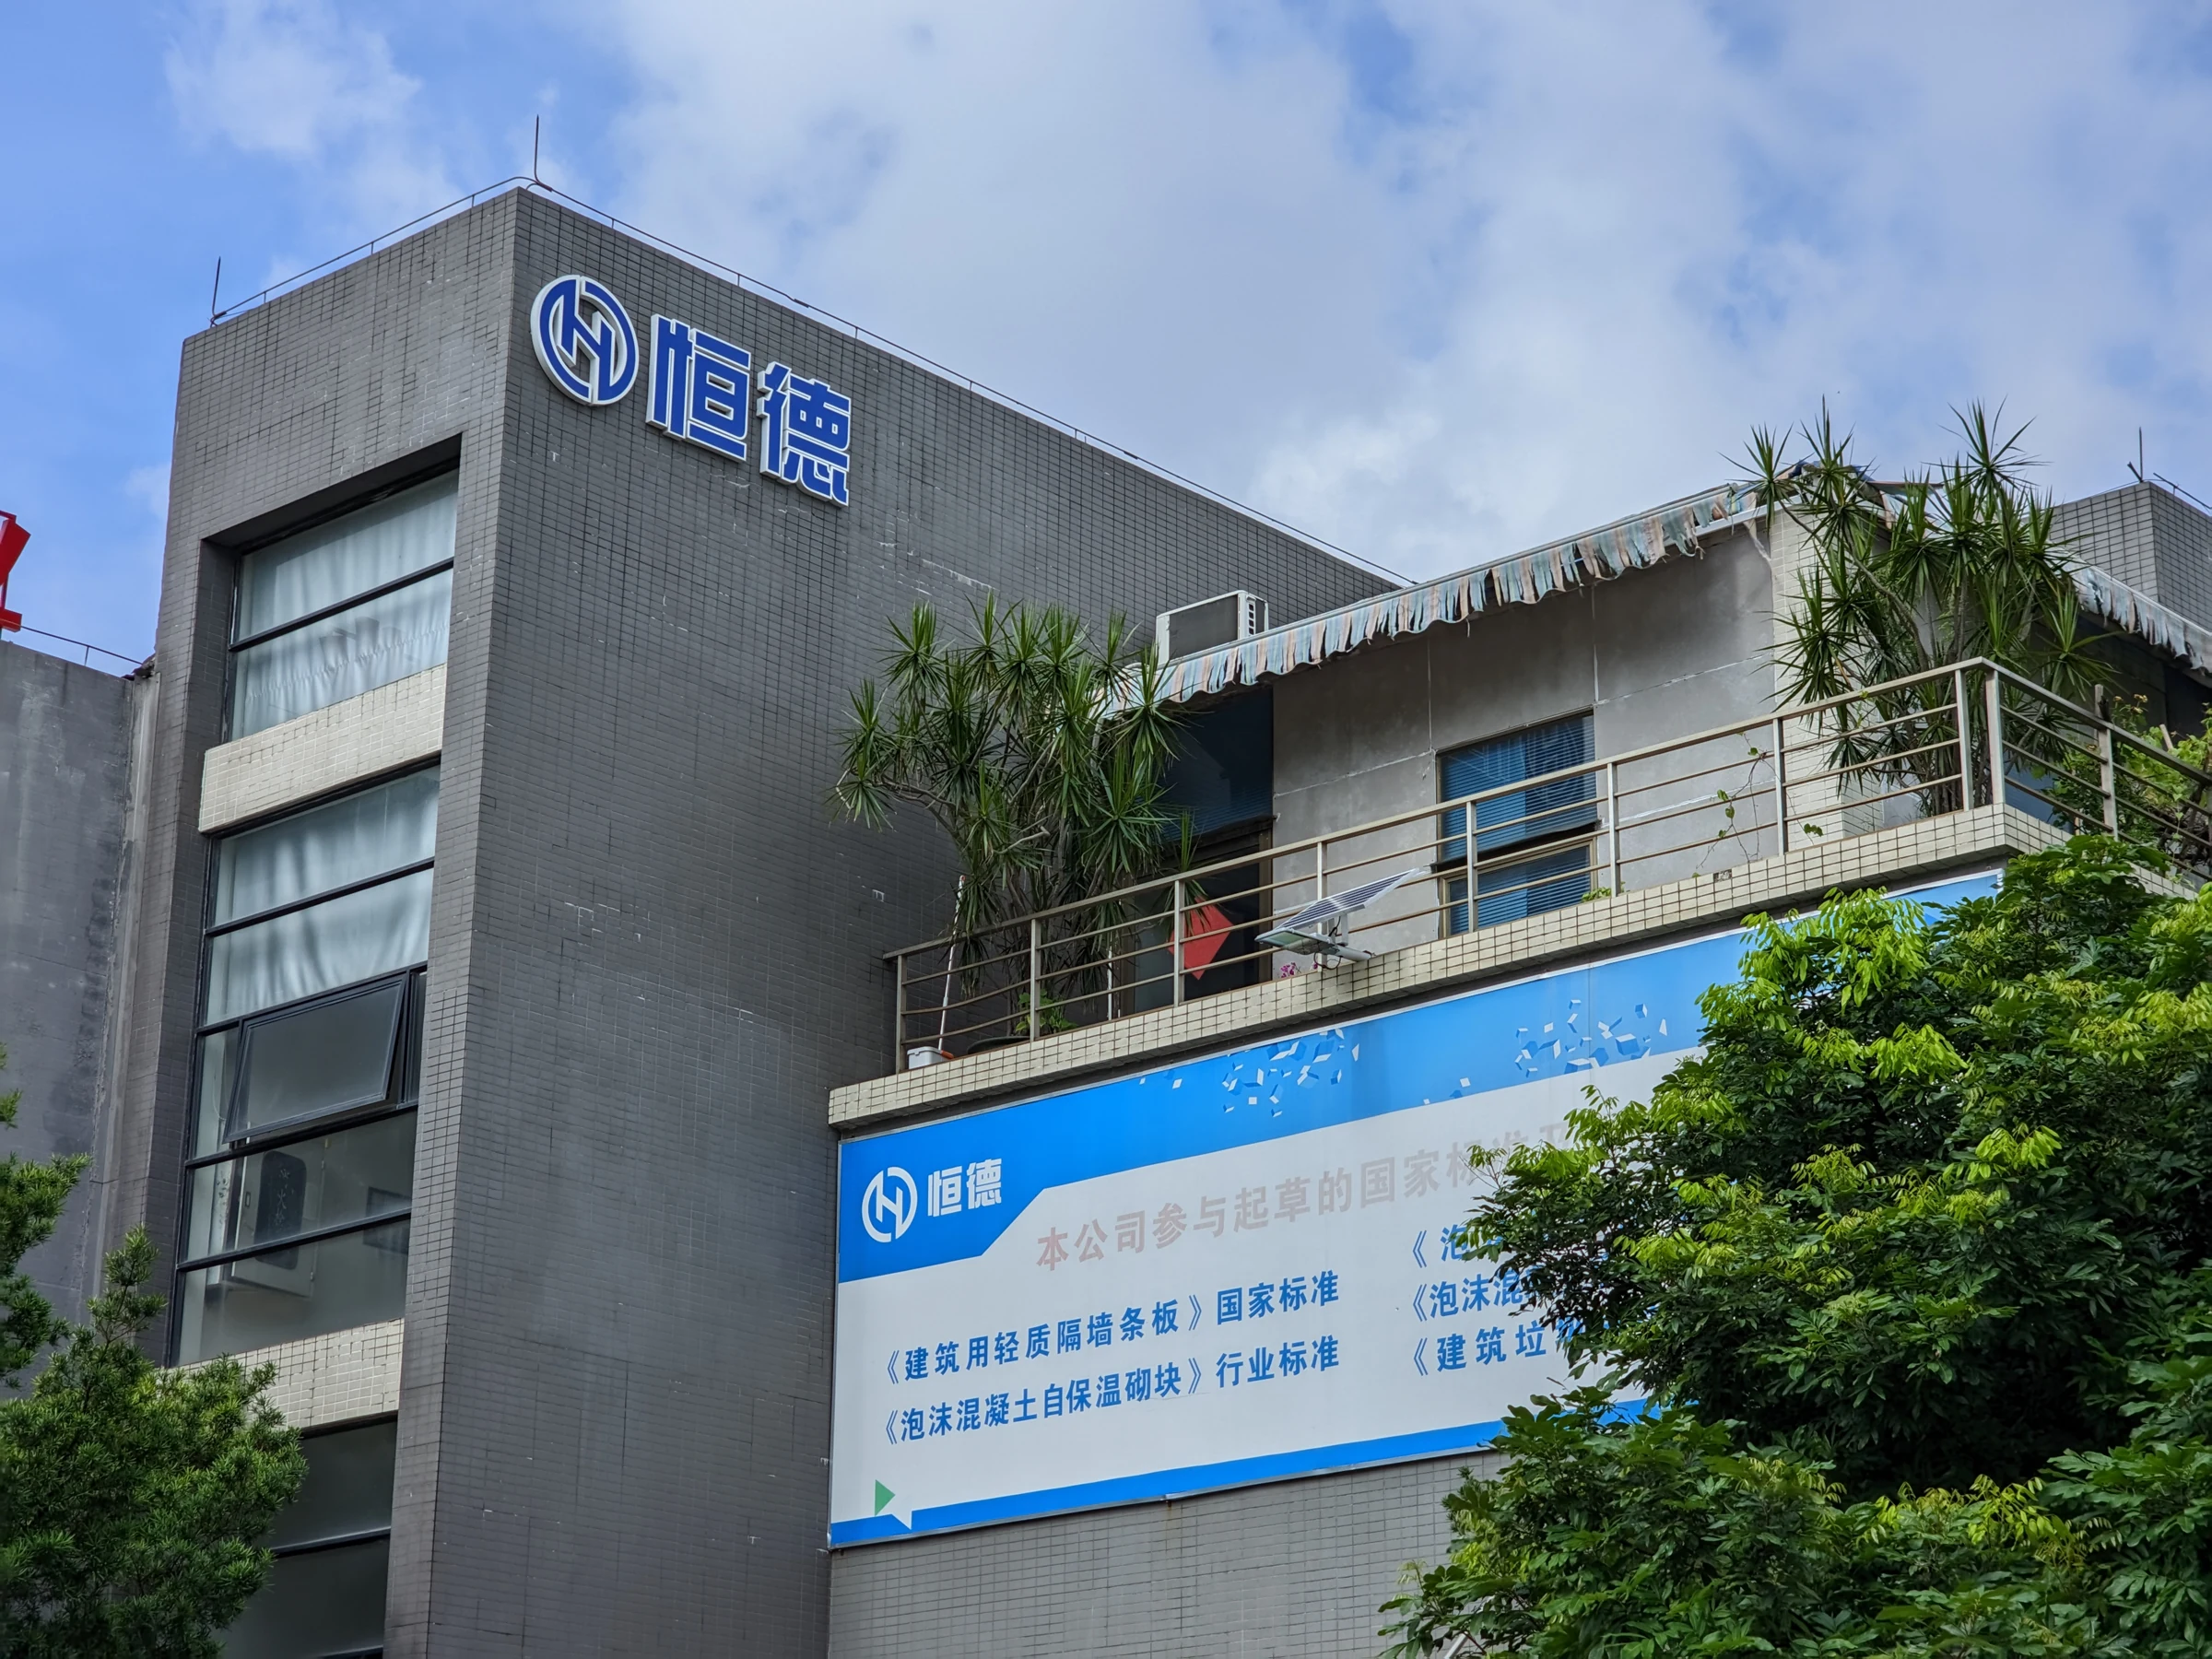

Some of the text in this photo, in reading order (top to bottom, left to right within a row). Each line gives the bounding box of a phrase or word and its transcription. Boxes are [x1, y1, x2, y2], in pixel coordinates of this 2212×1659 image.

[646, 313, 852, 508] 恒德
[927, 1158, 1003, 1218] 恒德
[886, 1269, 1340, 1385] 《建筑用轻质隔墙条板》国家标准
[1412, 1264, 1541, 1322] 《泡沫混
[886, 1335, 1340, 1445] 《泡沫混凝土自保温砌块》行业标准
